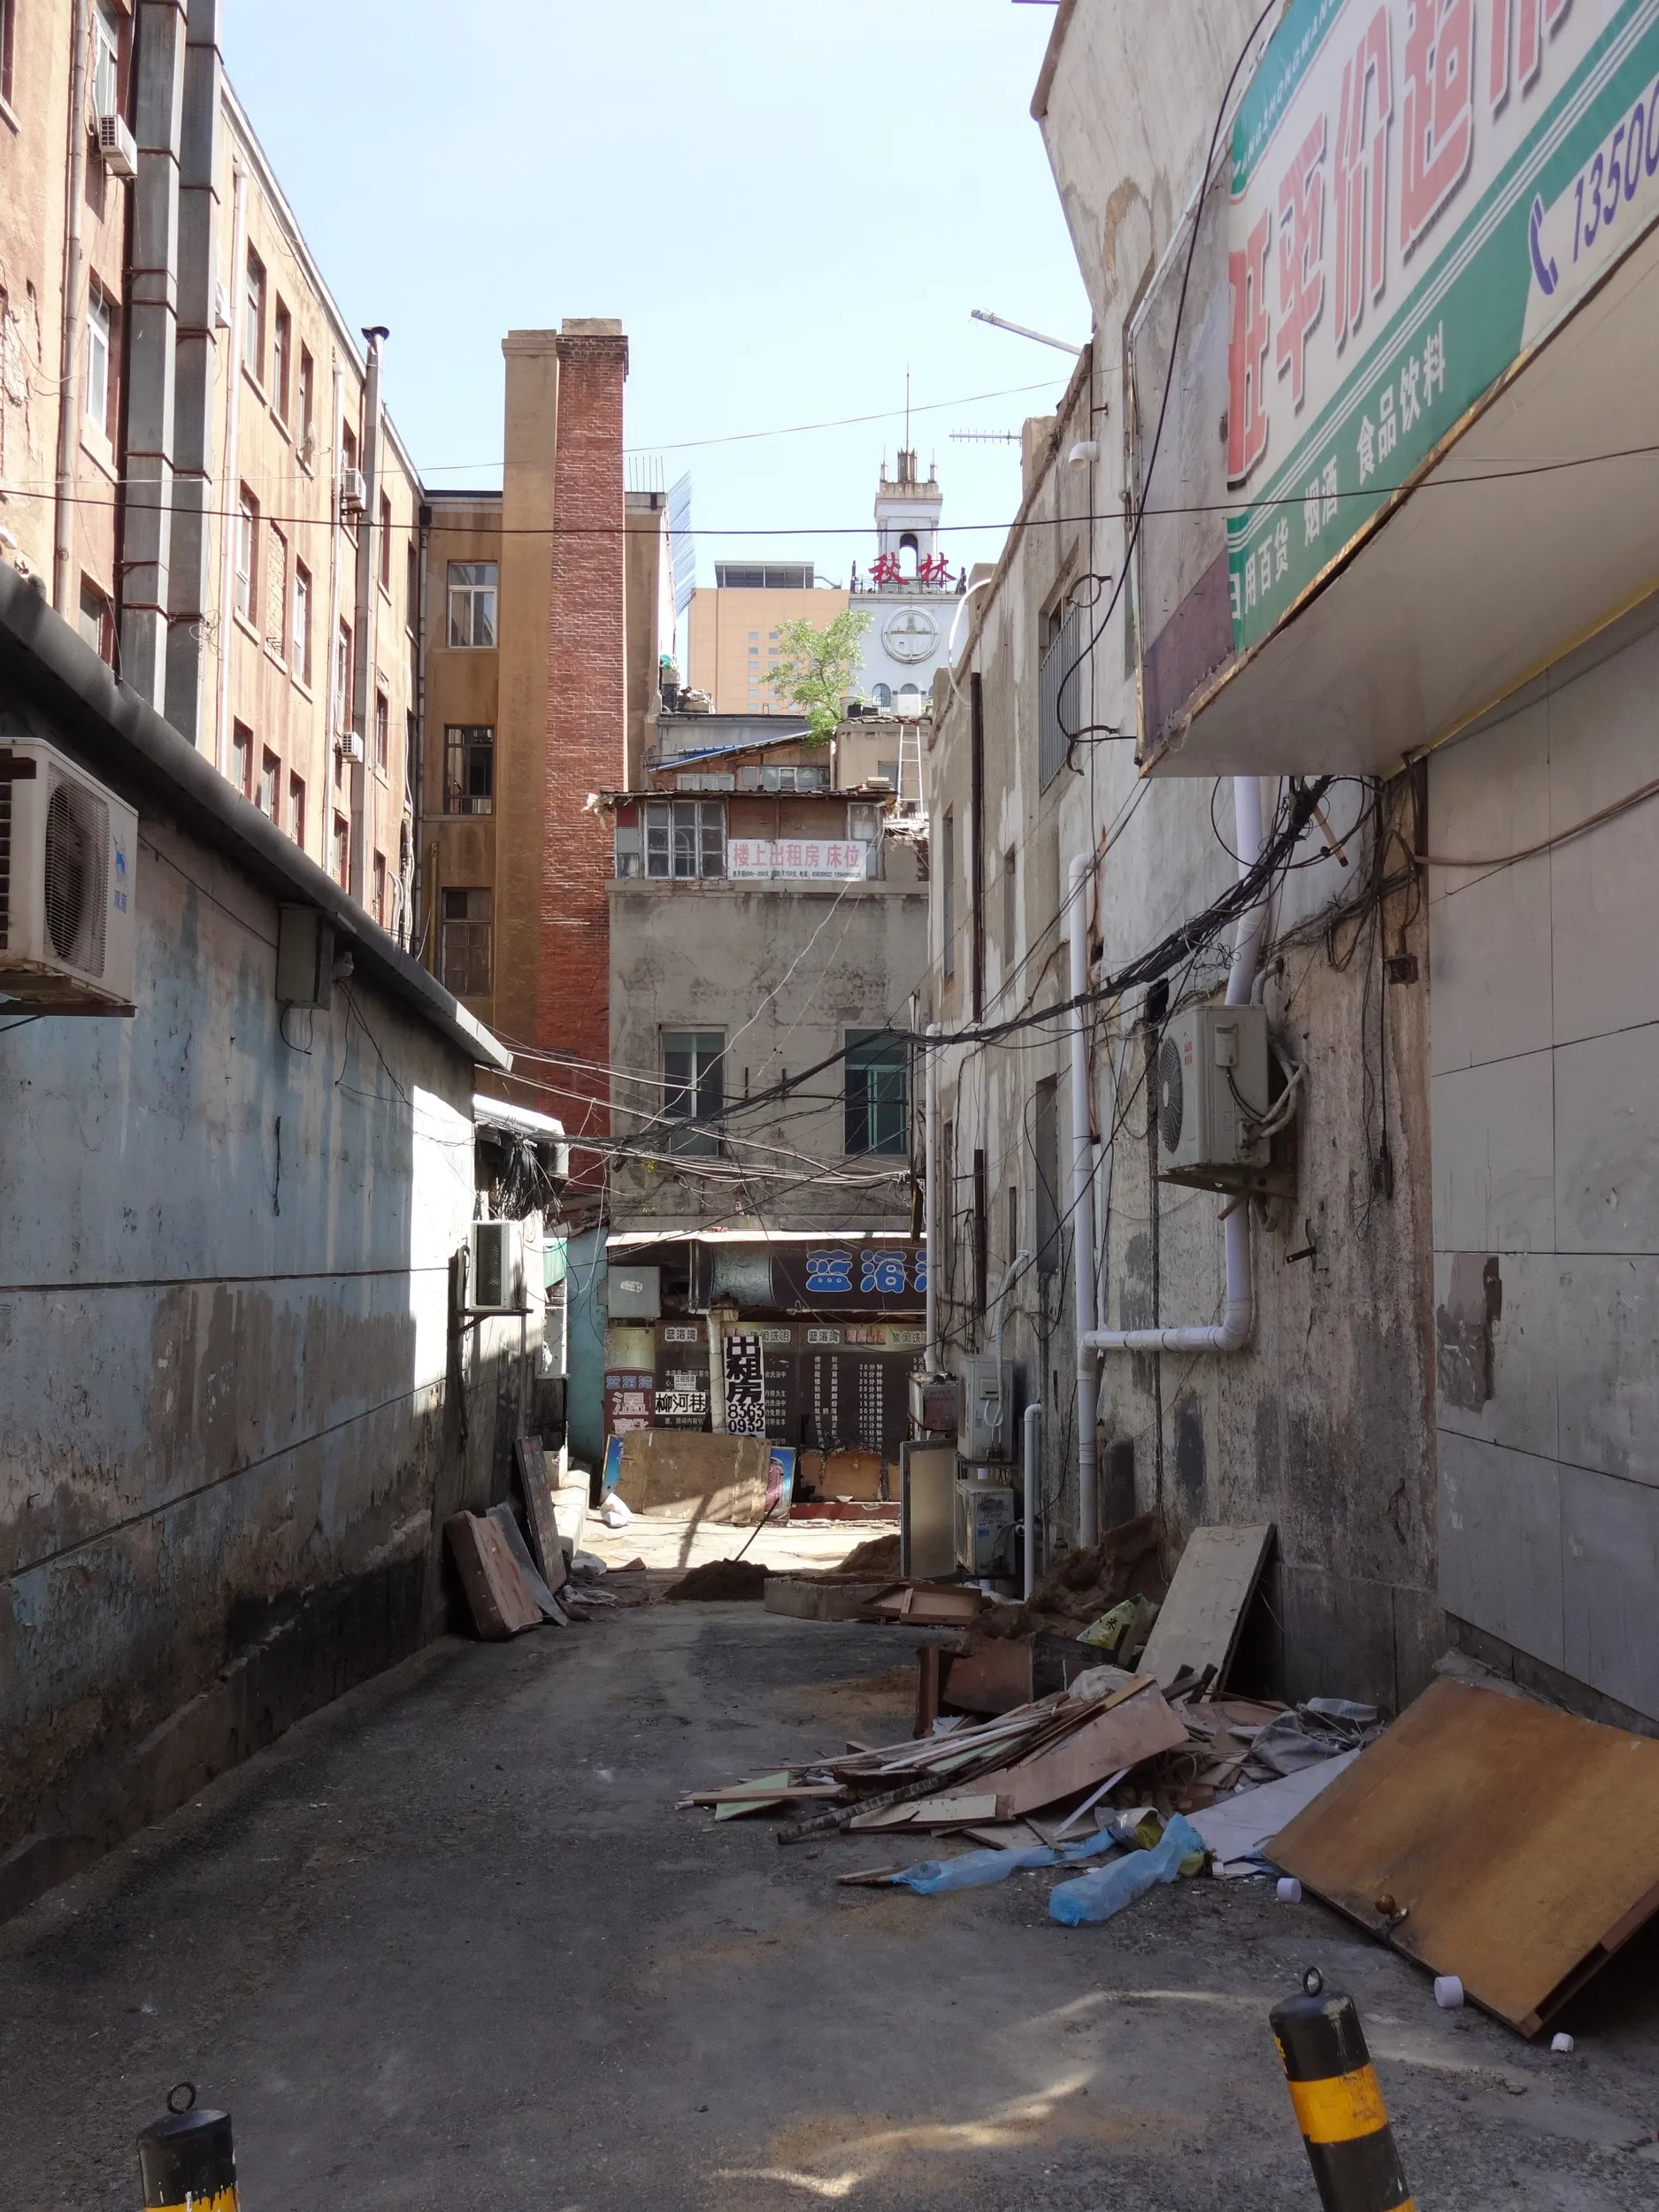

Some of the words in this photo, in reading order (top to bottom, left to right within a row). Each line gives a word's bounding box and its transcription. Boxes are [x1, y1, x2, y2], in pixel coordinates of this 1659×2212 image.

[1228, 516, 1289, 620] 日用百货
[1304, 455, 1339, 548] 烟酒
[1356, 319, 1447, 486] 食品饮料
[868, 551, 956, 589] 秋林
[733, 843, 821, 868] 楼上出租房
[826, 844, 860, 868] 床位
[805, 1248, 927, 1294] 蓝海
[665, 1328, 698, 1342] 蓝海湾
[807, 1328, 840, 1344] 蓝海湾
[726, 1336, 763, 1404] 出租房
[605, 1375, 653, 1390] 蓝海湾
[655, 1394, 706, 1414] 柳河巷
[727, 1402, 764, 1419] 8363
[727, 1417, 764, 1432] 0932
